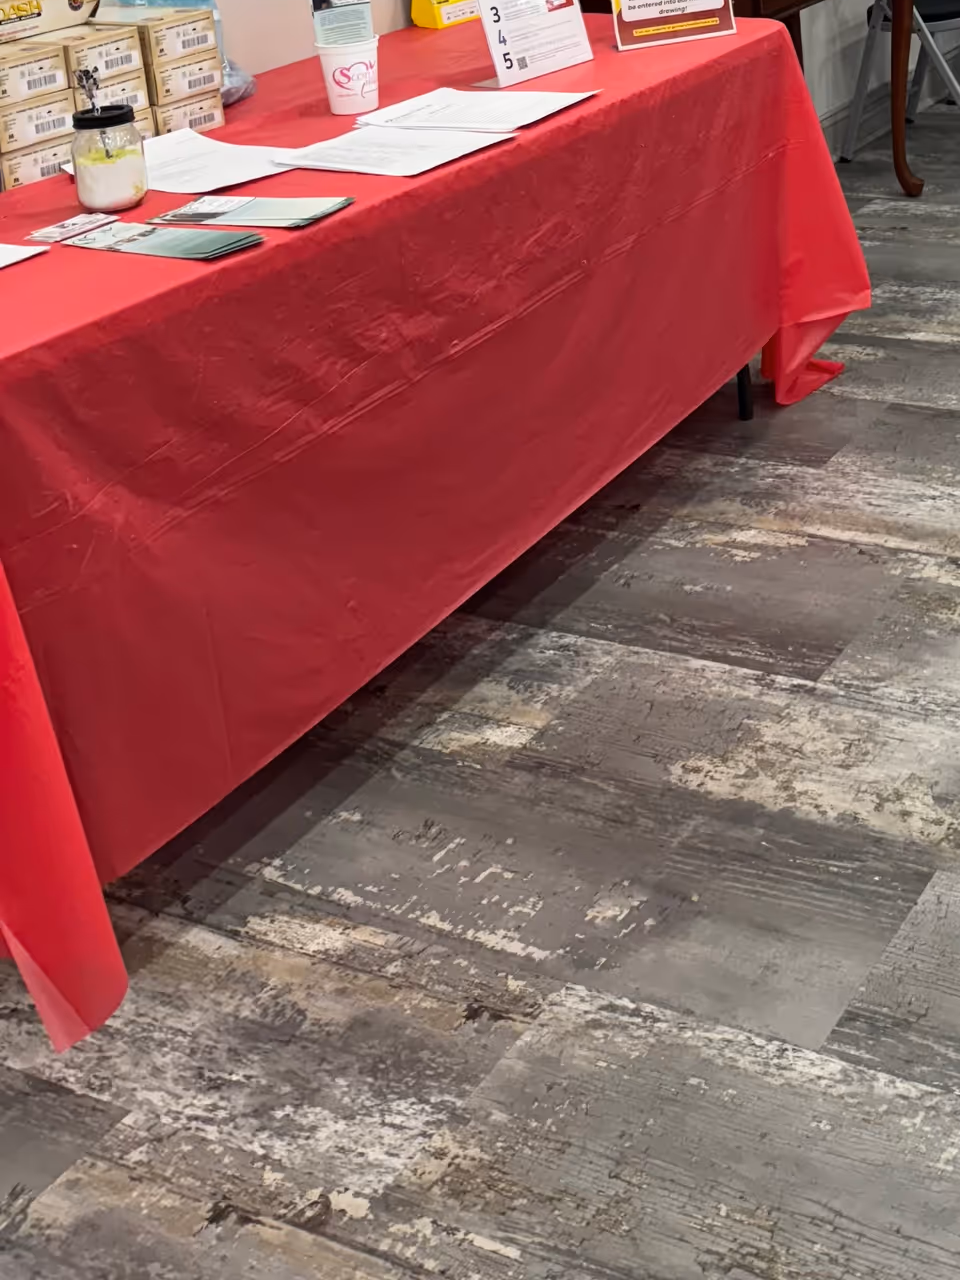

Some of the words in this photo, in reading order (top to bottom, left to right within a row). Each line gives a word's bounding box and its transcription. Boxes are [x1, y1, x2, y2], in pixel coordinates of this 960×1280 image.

[637, 0, 663, 9] entered
[658, 5, 688, 15] drawing!
[489, 6, 501, 23] 3
[498, 29, 507, 46] 4
[502, 51, 514, 70] 5
